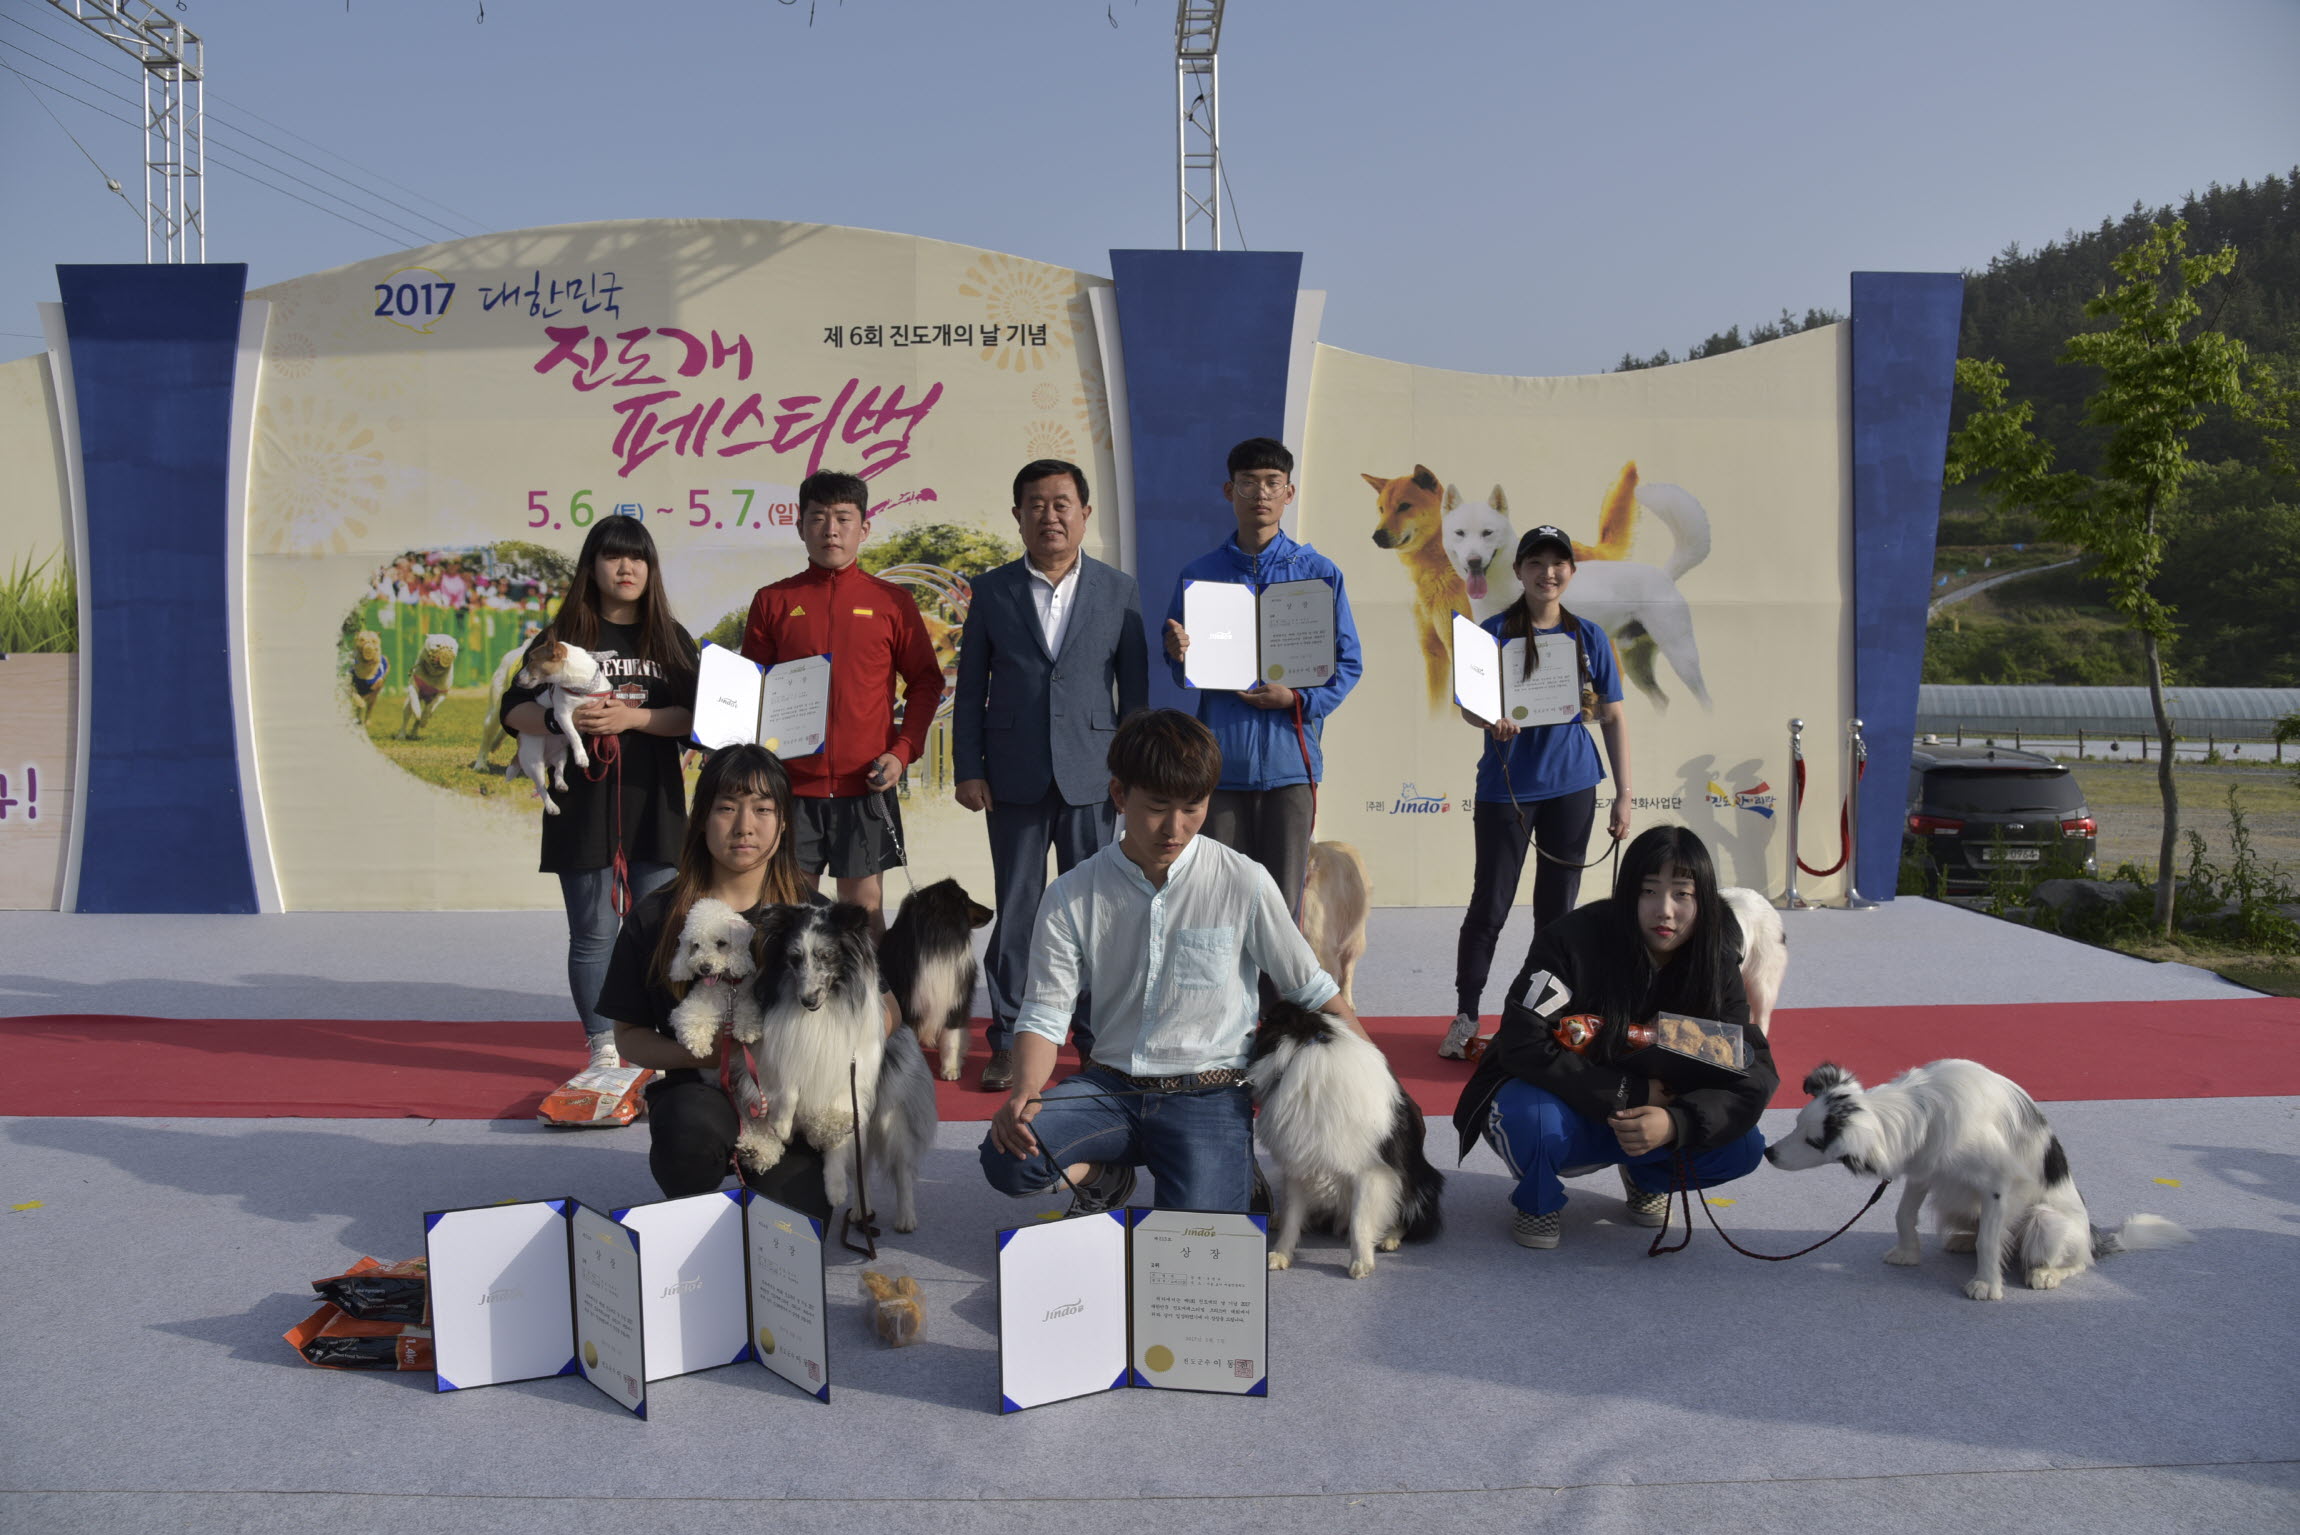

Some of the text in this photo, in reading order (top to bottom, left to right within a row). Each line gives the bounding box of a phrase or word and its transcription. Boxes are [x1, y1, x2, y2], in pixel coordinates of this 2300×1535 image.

[374, 270, 624, 320] 2017 대한민국
[533, 325, 753, 392] 진도개
[824, 323, 1047, 348] 제 6회 진도개의 날 기념
[611, 378, 944, 480] 페스티벌
[1523, 969, 1573, 1018] 17
